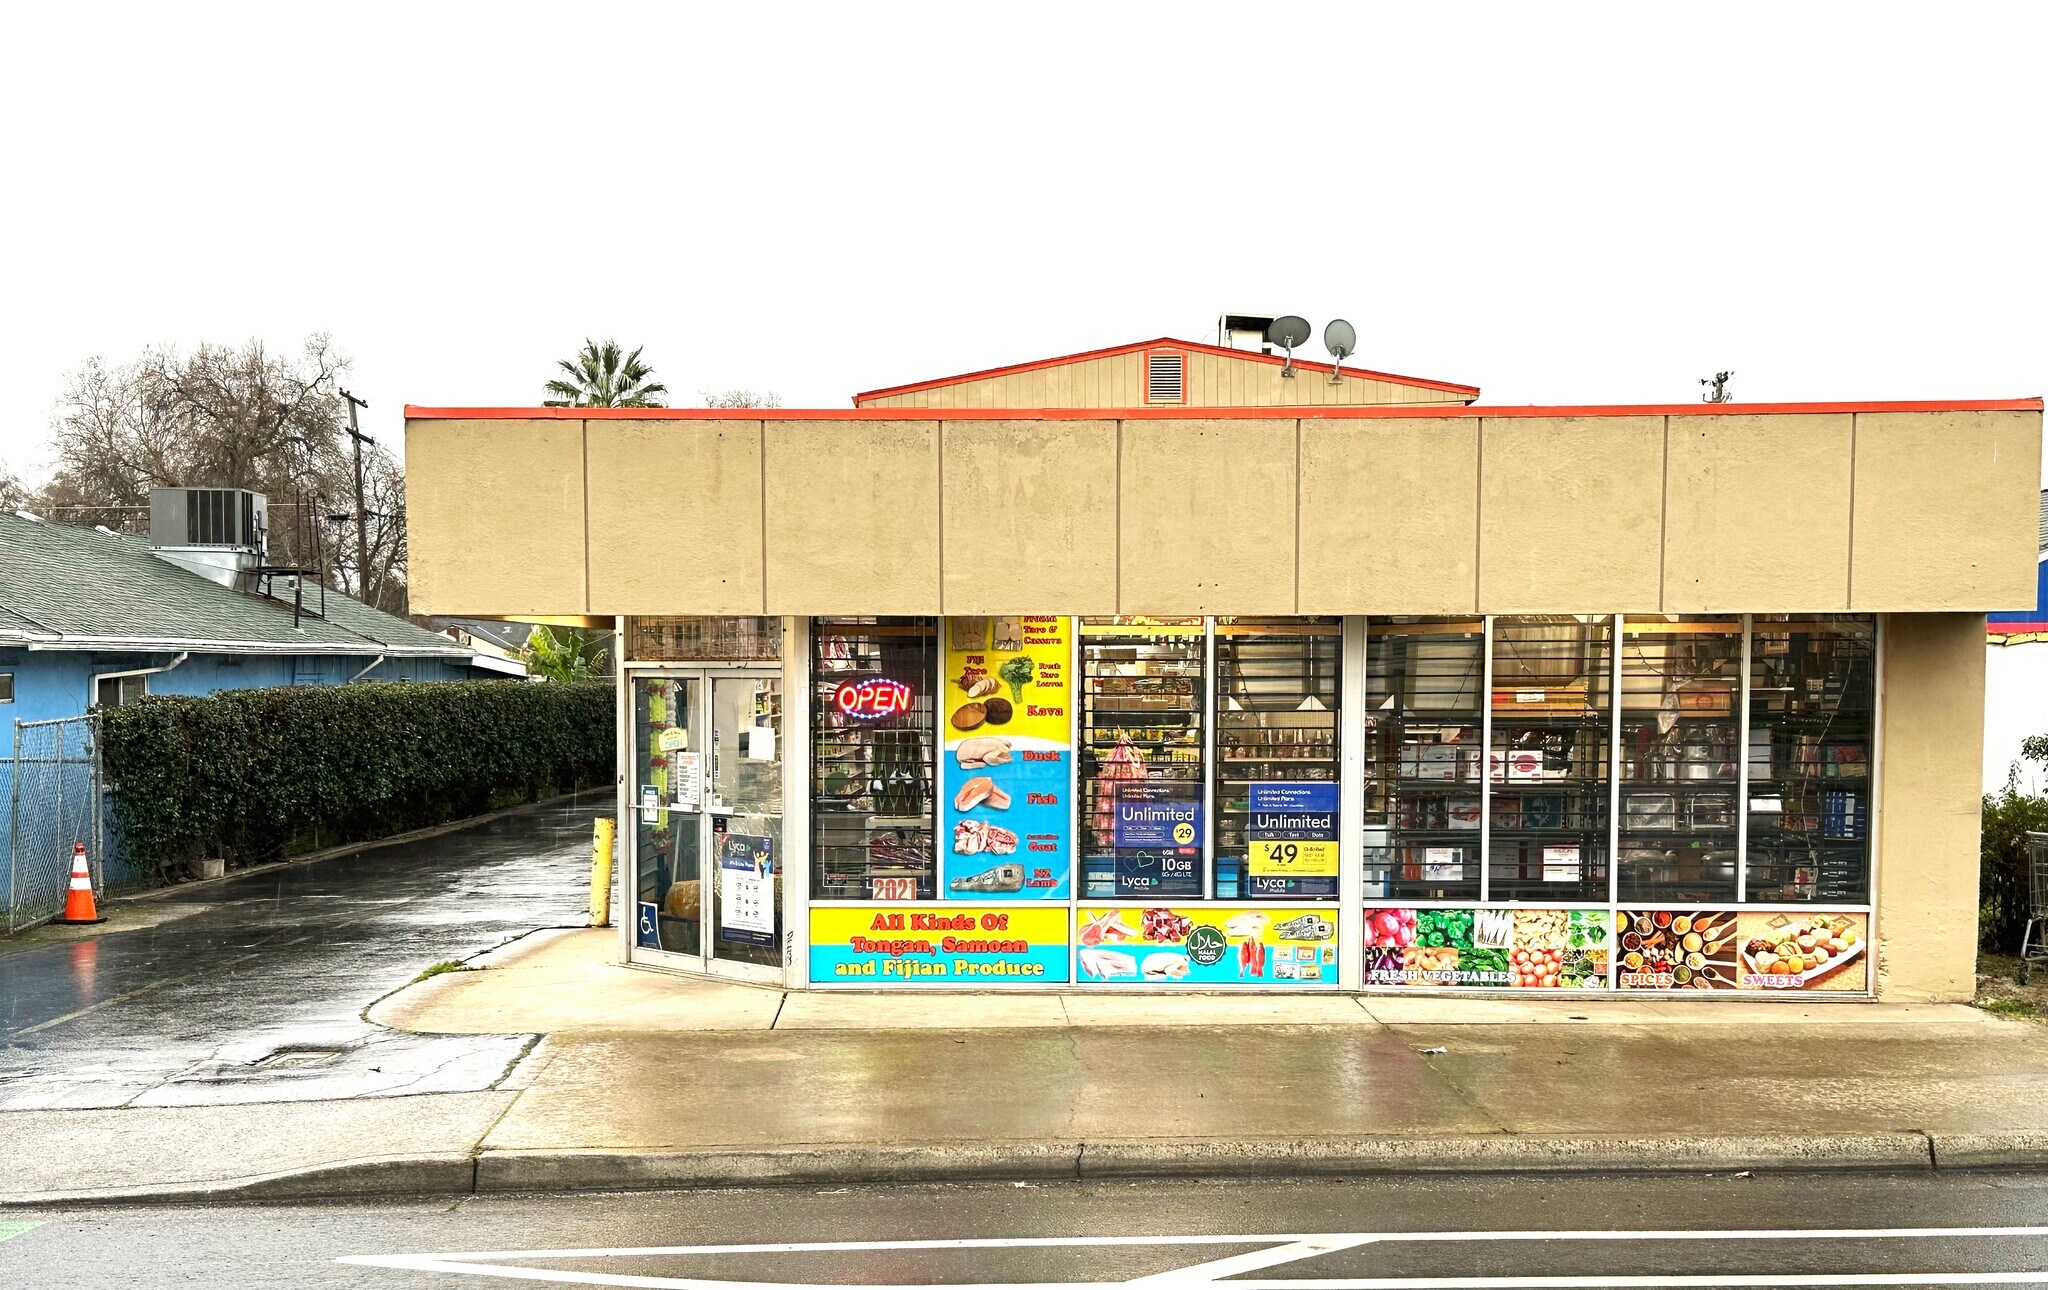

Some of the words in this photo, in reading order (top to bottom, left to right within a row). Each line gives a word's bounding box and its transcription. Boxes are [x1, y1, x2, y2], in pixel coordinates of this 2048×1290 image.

[1023, 625, 1047, 633] Taro
[1048, 625, 1058, 633] &
[1023, 636, 1062, 644] Cassava
[966, 655, 985, 664] Fiji
[964, 666, 988, 675] Taro
[1040, 671, 1059, 679] Taro
[839, 686, 911, 711] OPEN
[1027, 705, 1064, 717] Kava
[1022, 750, 1062, 762] Duck
[1027, 792, 1059, 805] Fish
[1122, 806, 1195, 821] Unlimited
[1257, 814, 1331, 829] Unlimited
[728, 840, 746, 853] Lyca
[1028, 842, 1058, 851] Goat
[1264, 843, 1298, 864] $49
[1033, 868, 1051, 879] NZ
[1026, 878, 1059, 888] Lamb
[1122, 875, 1150, 888] Lyca
[1256, 876, 1286, 890] Lyca
[873, 878, 916, 900] 2021
[870, 913, 905, 931] All
[910, 913, 975, 931] Kinds
[980, 913, 1009, 931] Of
[850, 936, 936, 956] Tongan,
[941, 936, 1028, 953] Samoan
[1189, 931, 1223, 950] حلال
[834, 959, 876, 976] and
[882, 959, 947, 979] Fijian
[953, 959, 1045, 976] Produce
[1370, 969, 1419, 983] FRESH
[1422, 970, 1517, 983] VEGETABLES
[1619, 973, 1674, 987] SPICES
[1742, 973, 1805, 988] SWEETS
